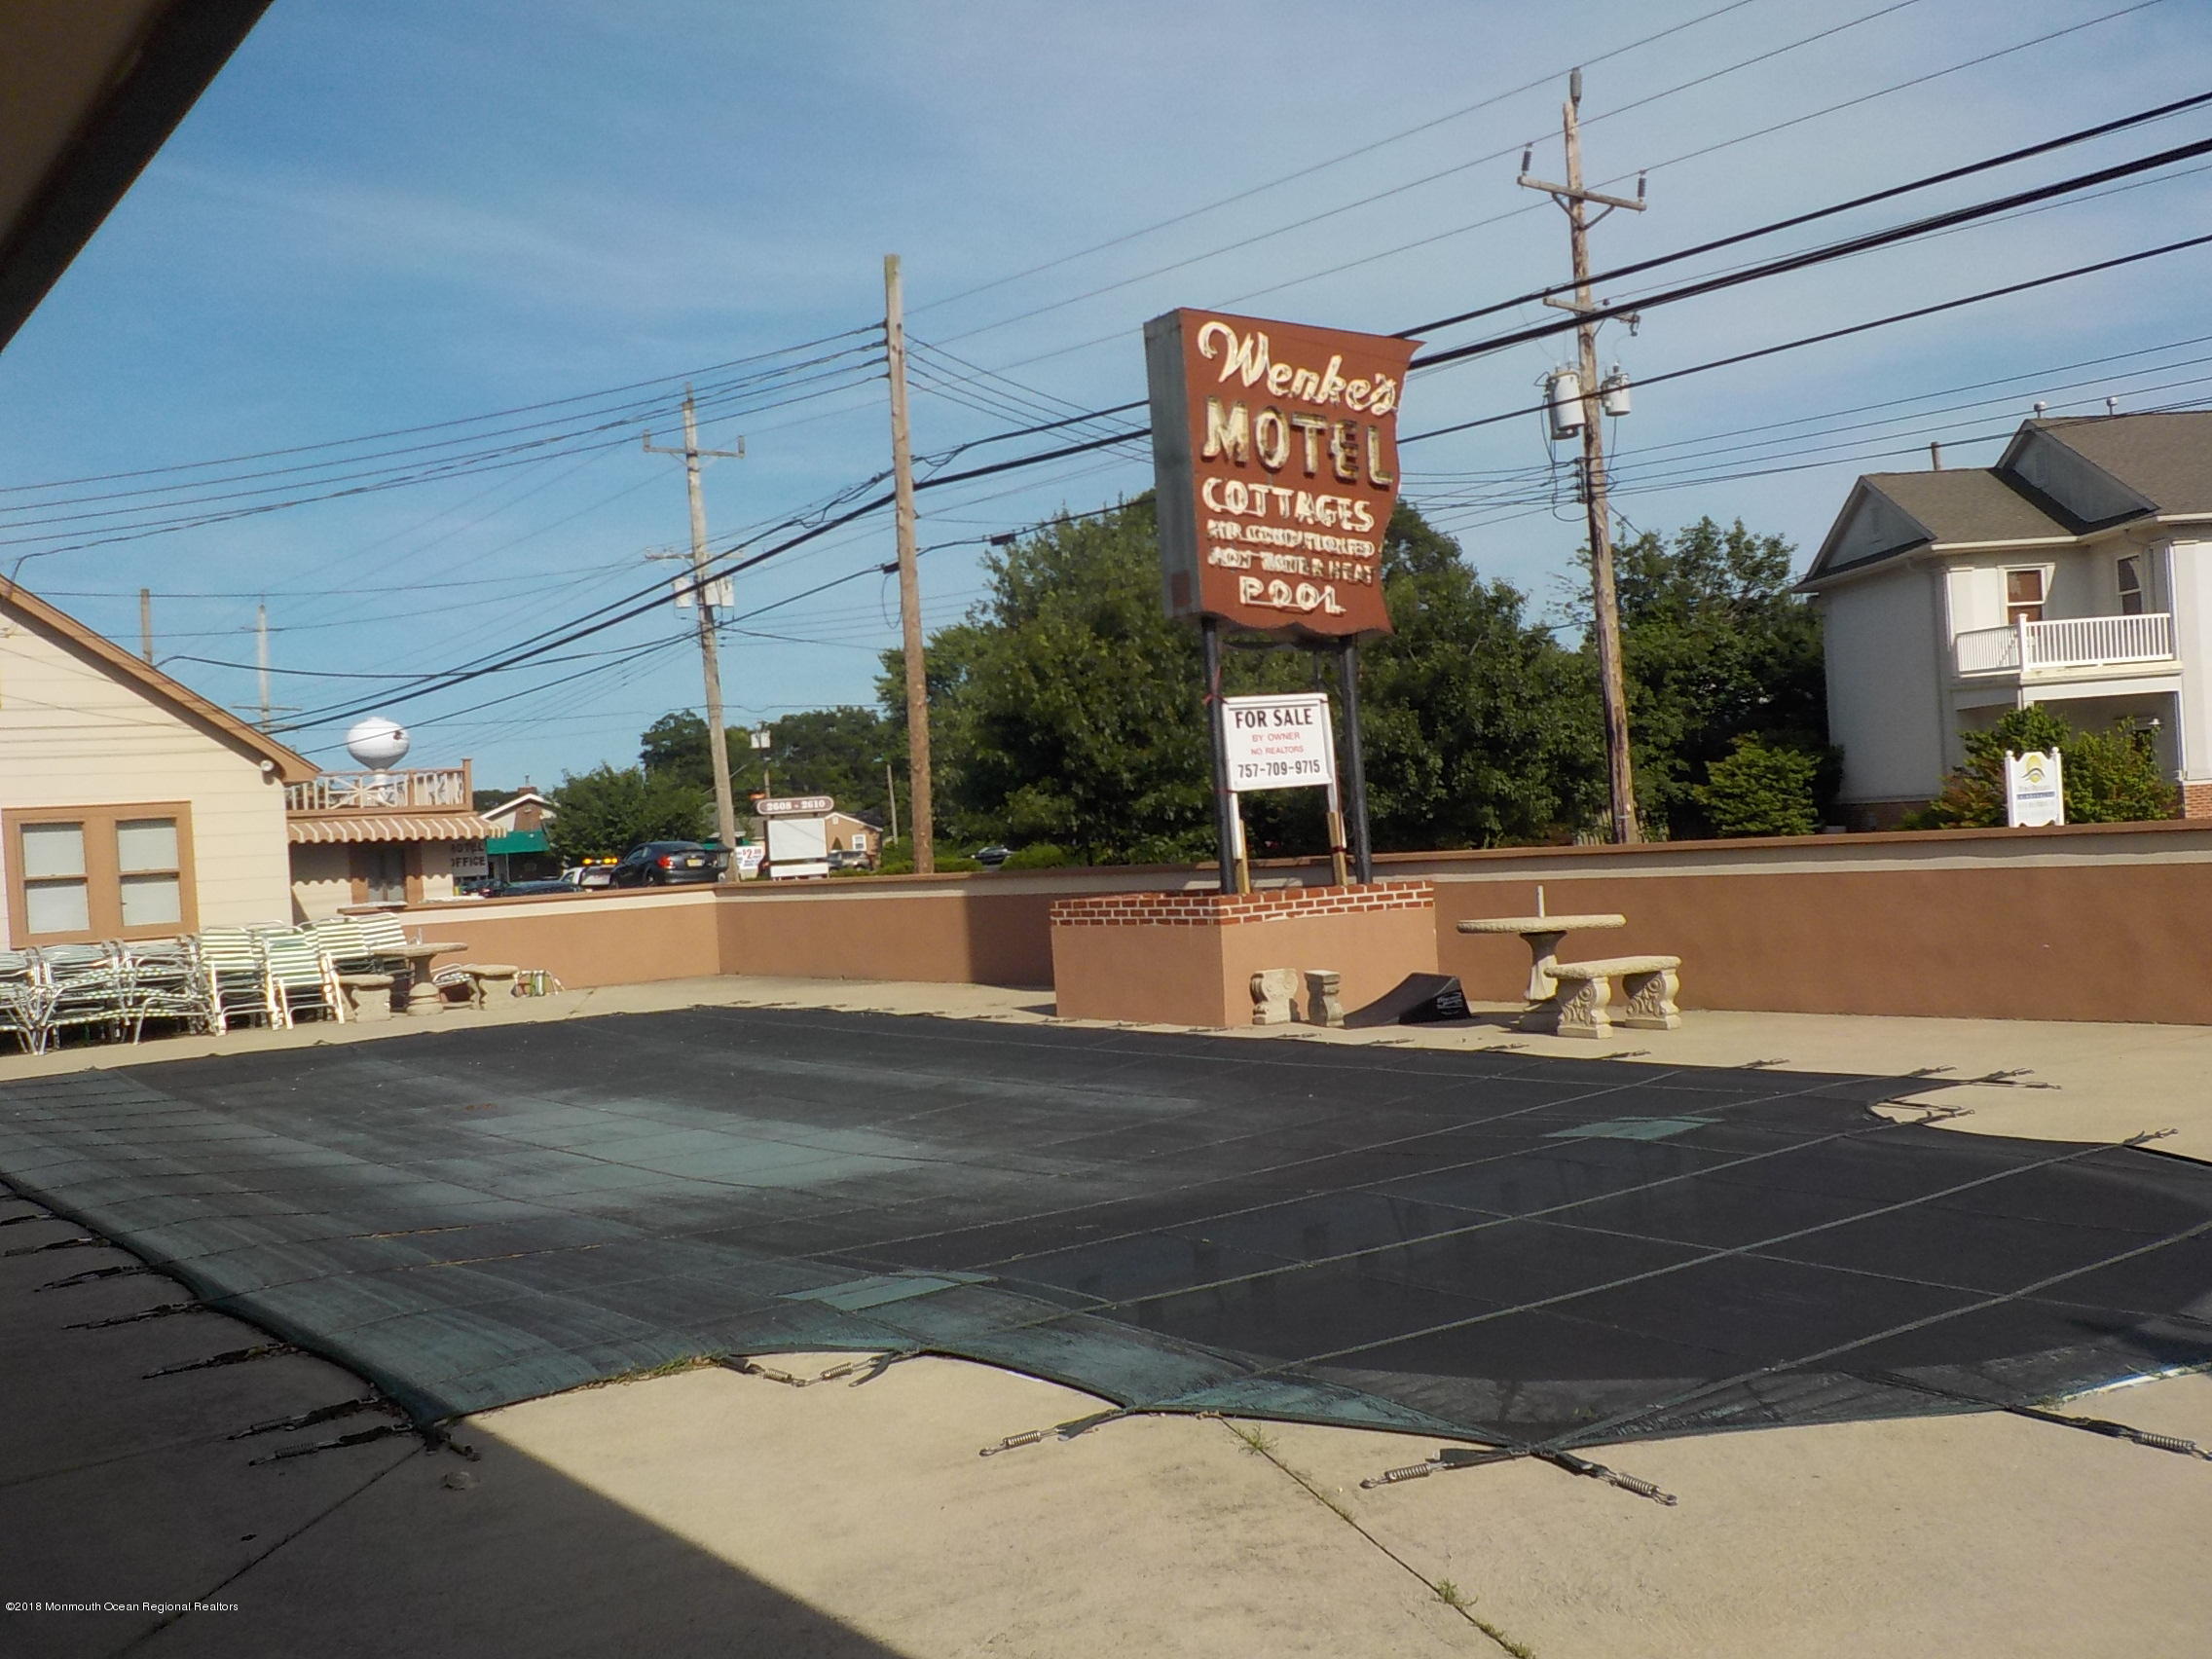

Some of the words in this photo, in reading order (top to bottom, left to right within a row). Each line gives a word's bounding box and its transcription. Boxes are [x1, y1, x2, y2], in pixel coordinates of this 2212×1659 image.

[1198, 320, 1398, 416] Wenke's
[1201, 395, 1393, 487] MOTEL
[1201, 476, 1374, 533] COTTAGES
[1239, 575, 1346, 615] POOL
[1235, 711, 1268, 729] FOR
[1273, 708, 1313, 727] SALE
[1251, 747, 1263, 756] NO
[1265, 746, 1305, 755] REALTORS
[1252, 733, 1264, 742] BY
[1268, 732, 1300, 742] OWNER
[1237, 759, 1321, 778] 757-709-9715
